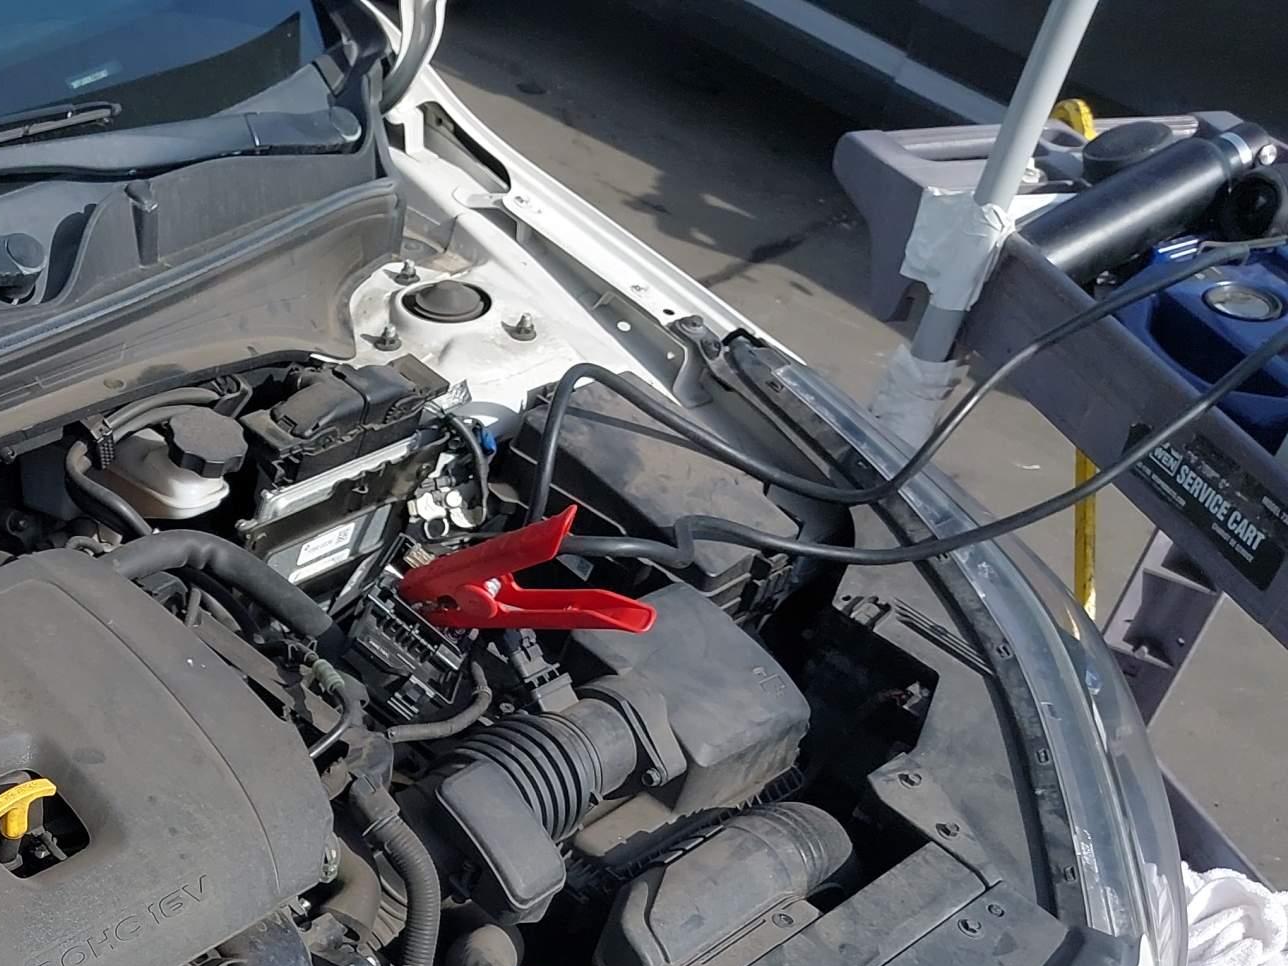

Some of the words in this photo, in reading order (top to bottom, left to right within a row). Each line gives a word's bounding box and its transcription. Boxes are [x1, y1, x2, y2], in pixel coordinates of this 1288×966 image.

[1176, 465, 1231, 522] SERVICE
[1227, 510, 1266, 550] CART
[147, 873, 208, 925] 16V
